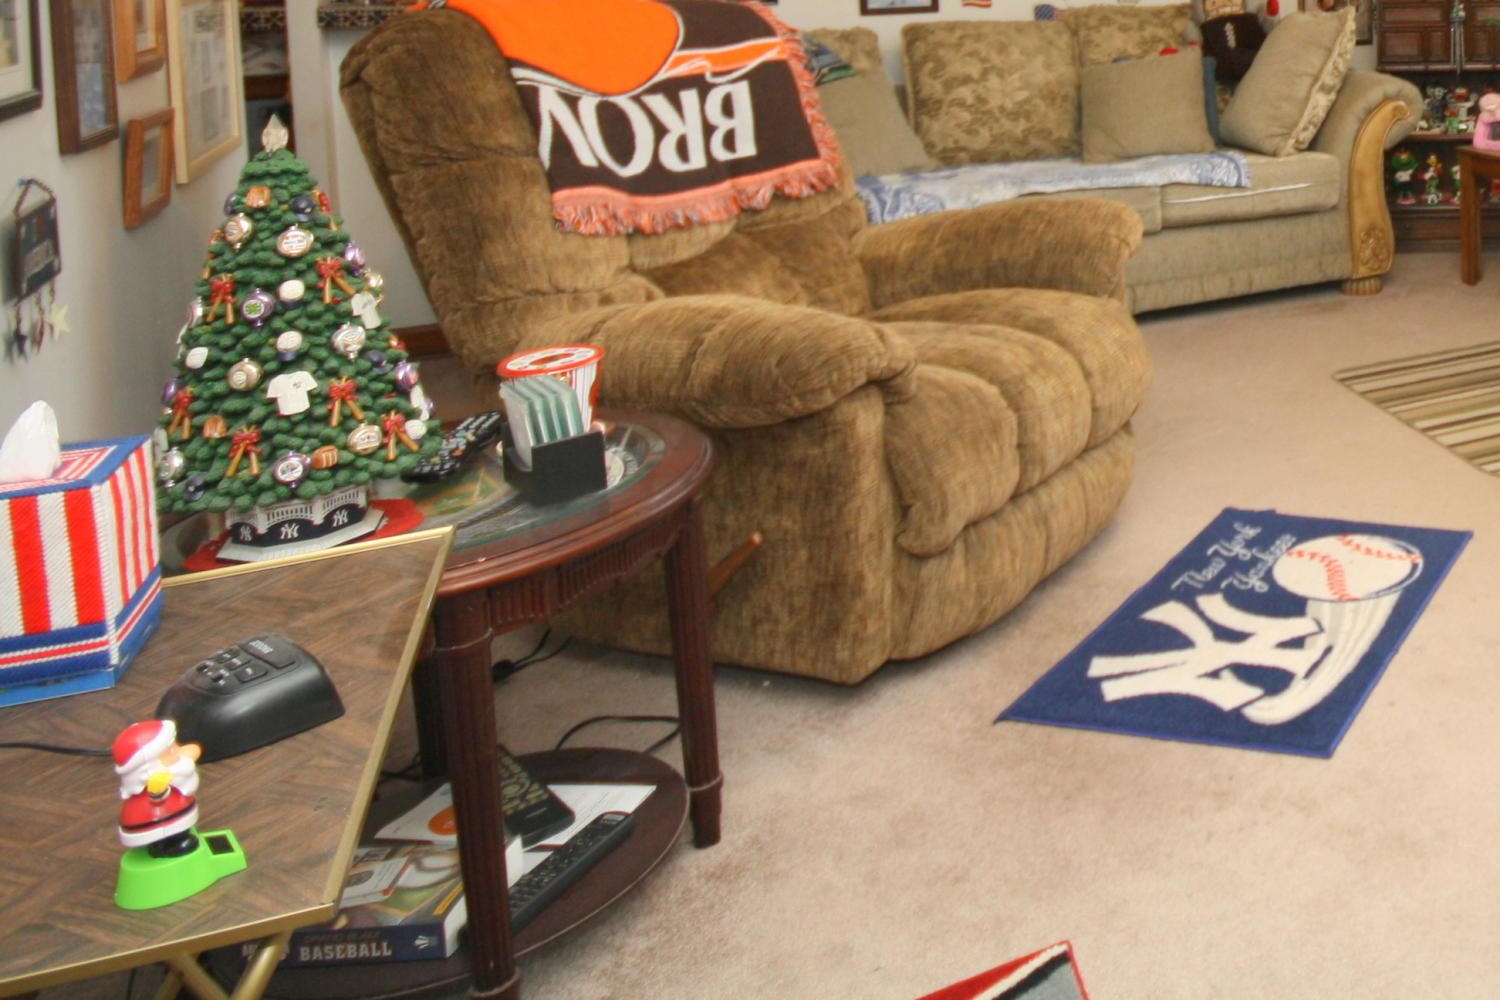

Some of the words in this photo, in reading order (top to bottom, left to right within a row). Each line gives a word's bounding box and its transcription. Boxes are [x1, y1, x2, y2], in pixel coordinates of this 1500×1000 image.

[333, 508, 349, 527] NY
[280, 522, 300, 540] NY
[300, 941, 393, 962] BASEBALL
